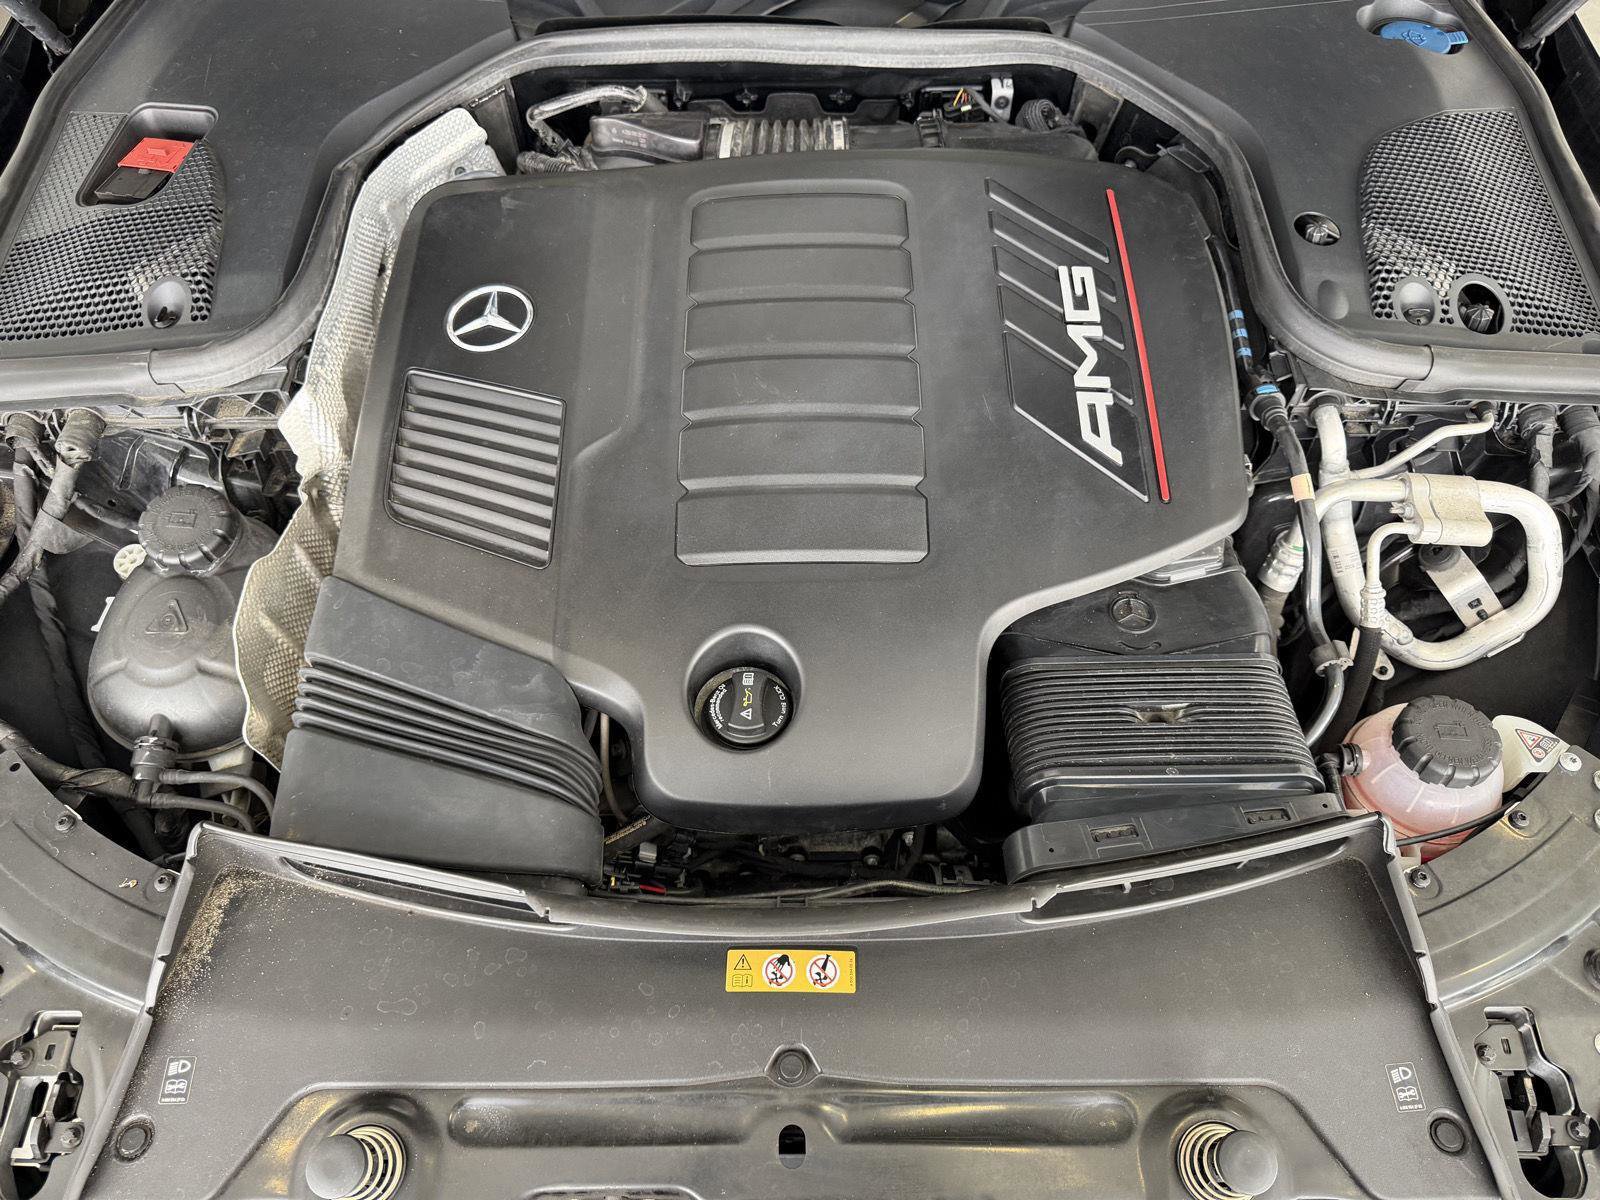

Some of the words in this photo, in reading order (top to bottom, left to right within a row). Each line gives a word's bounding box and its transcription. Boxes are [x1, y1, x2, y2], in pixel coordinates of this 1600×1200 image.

[1058, 265, 1123, 467] AMG
[773, 685, 786, 701] CLICK
[772, 715, 784, 727] Turn
